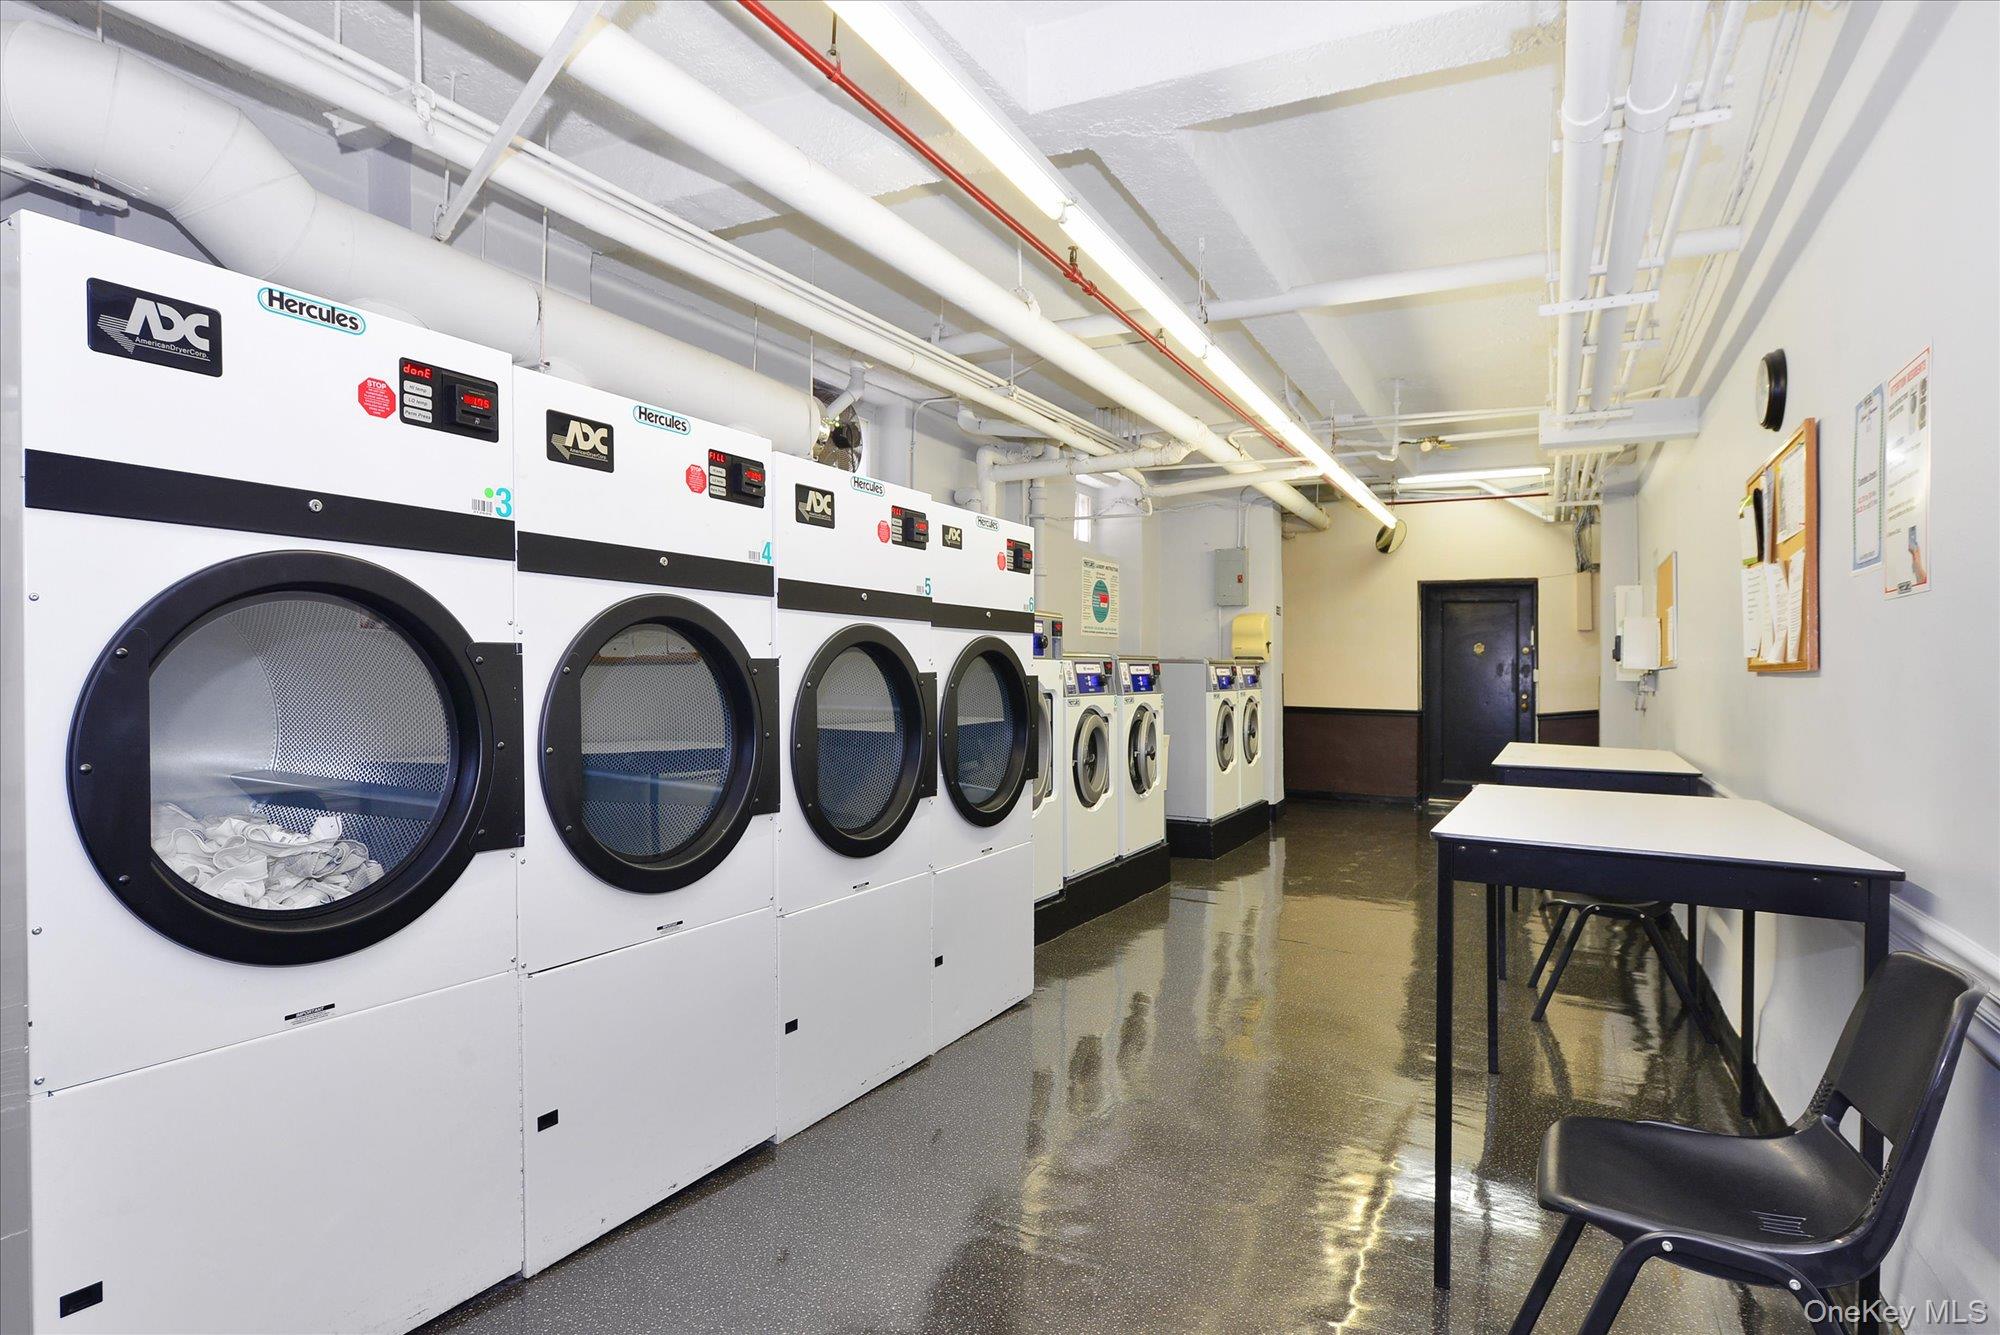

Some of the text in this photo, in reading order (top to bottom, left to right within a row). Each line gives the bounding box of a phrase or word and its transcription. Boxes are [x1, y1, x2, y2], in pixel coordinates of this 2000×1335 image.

[267, 288, 359, 331] Hercules
[124, 297, 210, 352] ADC
[366, 380, 387, 389] STOP
[638, 406, 687, 431] Hercules
[565, 419, 608, 455] ADC
[853, 476, 883, 494] Hercules
[496, 487, 512, 517] 3
[806, 490, 832, 516] ADC
[948, 527, 961, 542] ADC
[761, 541, 772, 564] 4
[924, 577, 931, 596] 5
[1029, 596, 1034, 612] 6
